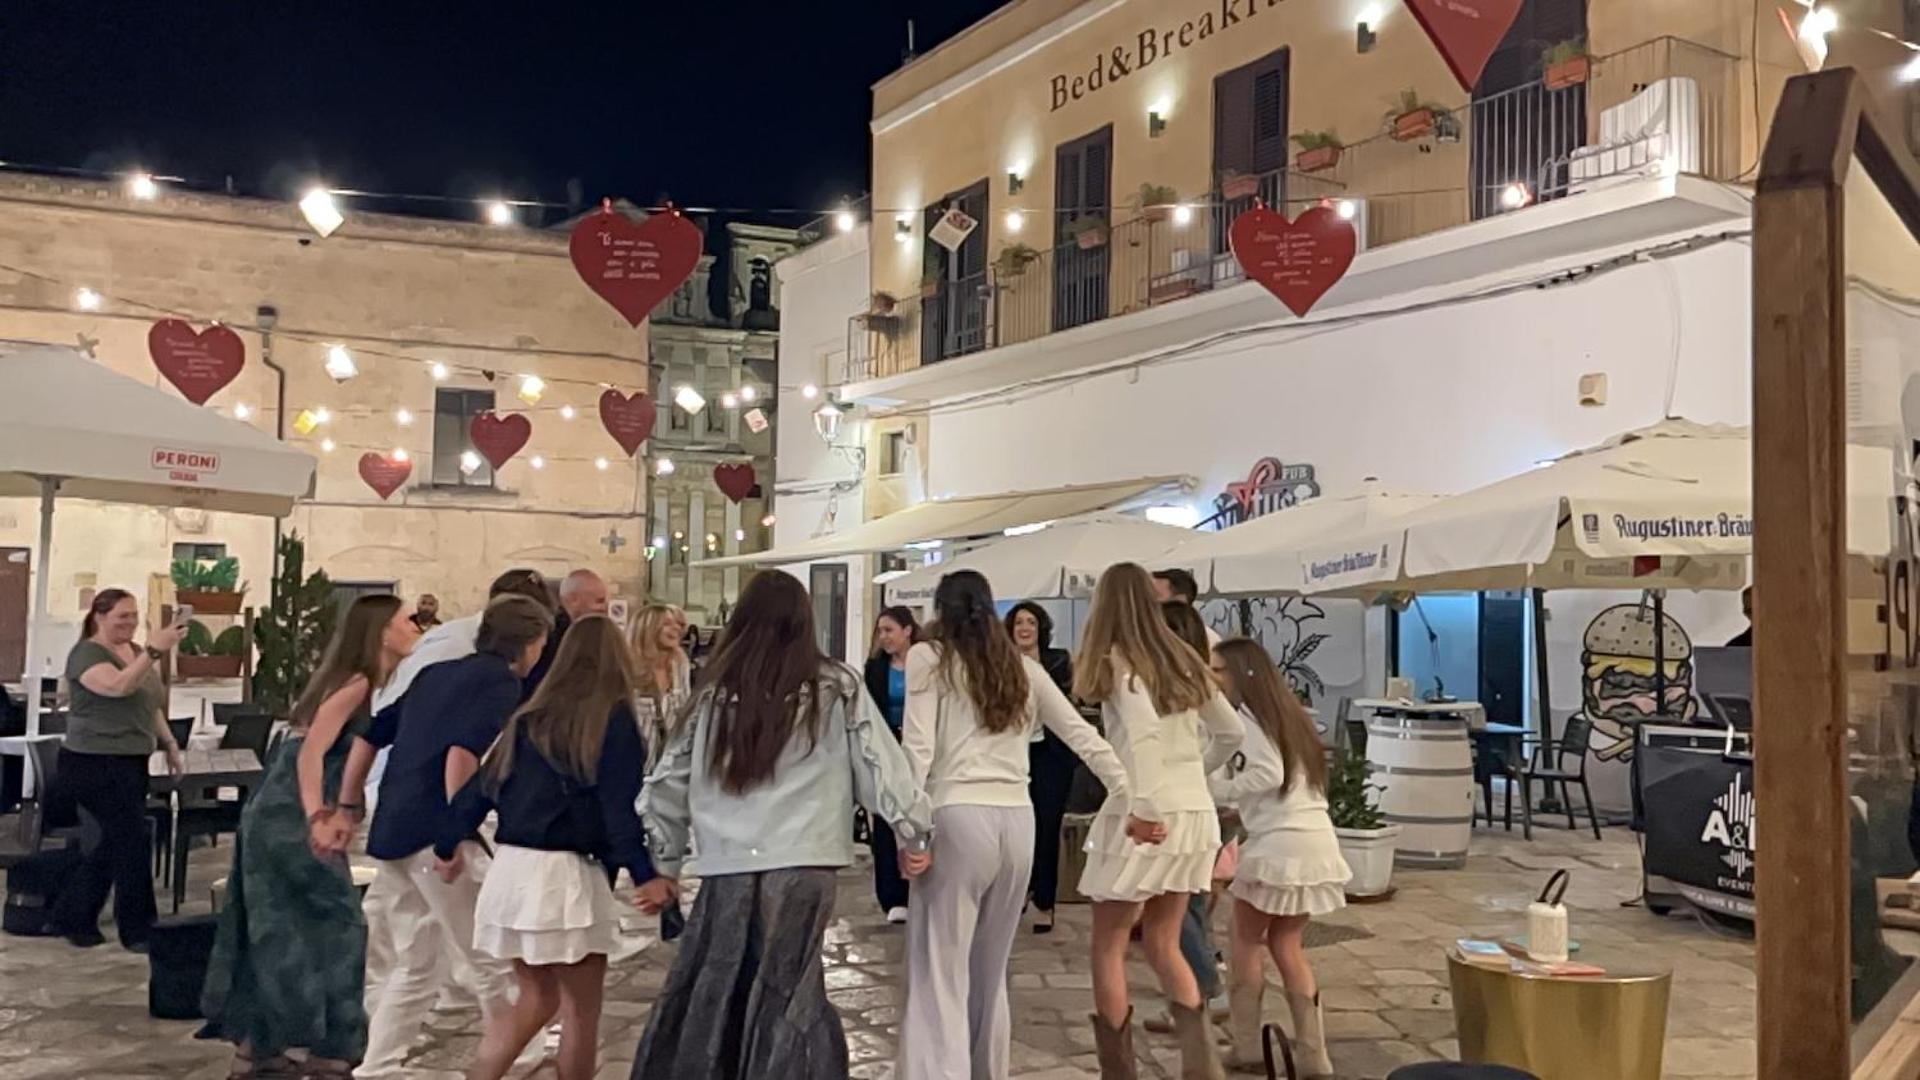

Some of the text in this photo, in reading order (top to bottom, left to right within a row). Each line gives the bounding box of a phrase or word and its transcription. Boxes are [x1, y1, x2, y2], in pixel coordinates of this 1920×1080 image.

[1050, 0, 1284, 112] Bed&Break
[156, 451, 216, 468] PERONI
[1282, 466, 1307, 480] PUB
